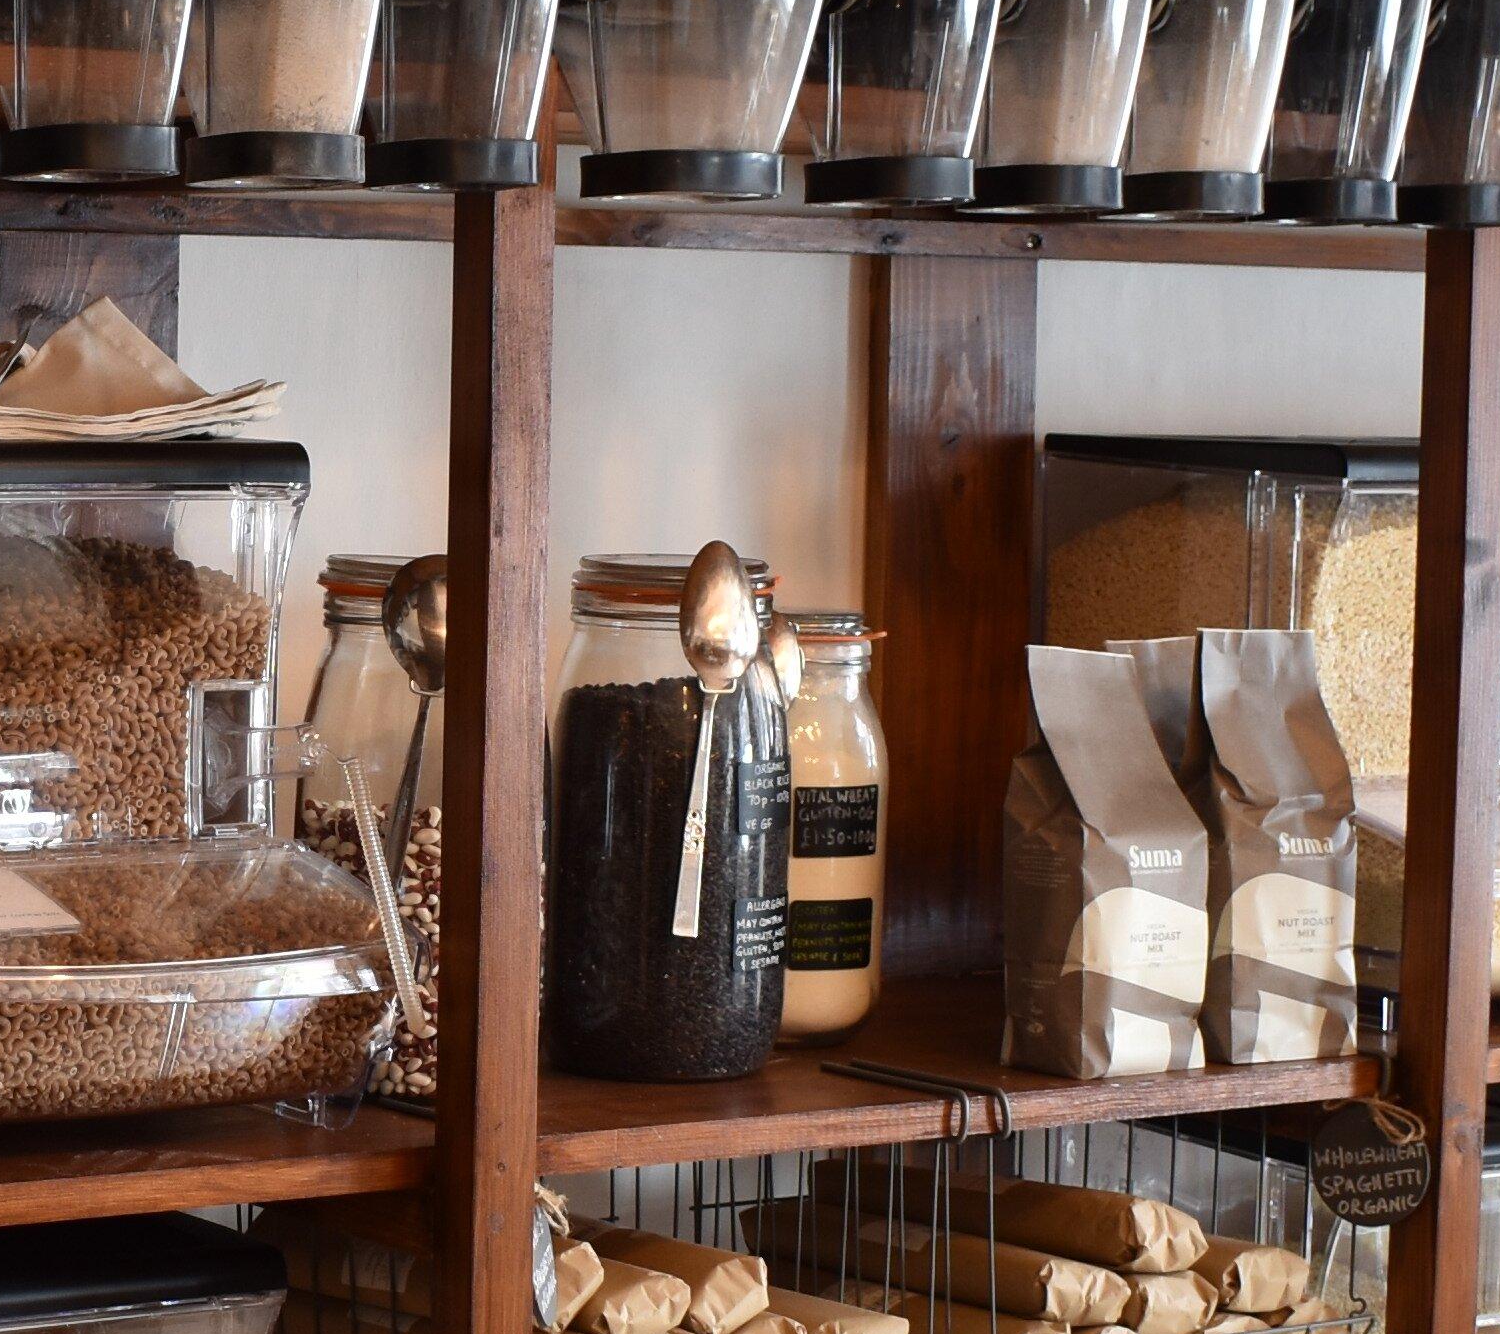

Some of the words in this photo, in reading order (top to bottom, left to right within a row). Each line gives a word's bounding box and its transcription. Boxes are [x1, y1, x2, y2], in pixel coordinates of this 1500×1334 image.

[796, 788, 834, 806] VITAL
[1279, 831, 1334, 856] Suma
[1128, 843, 1183, 869] Suma
[1277, 917, 1300, 928] NUT
[1302, 916, 1335, 927] ROAST
[1130, 932, 1151, 944] NUT
[1151, 930, 1182, 942] ROAST
[1297, 929, 1316, 939] MIX
[1146, 943, 1164, 954] MIX
[1313, 1142, 1425, 1170] WHOLEWHEAT
[1321, 1168, 1422, 1198] SPAGHETTI
[1337, 1193, 1420, 1216] ORGANIC
